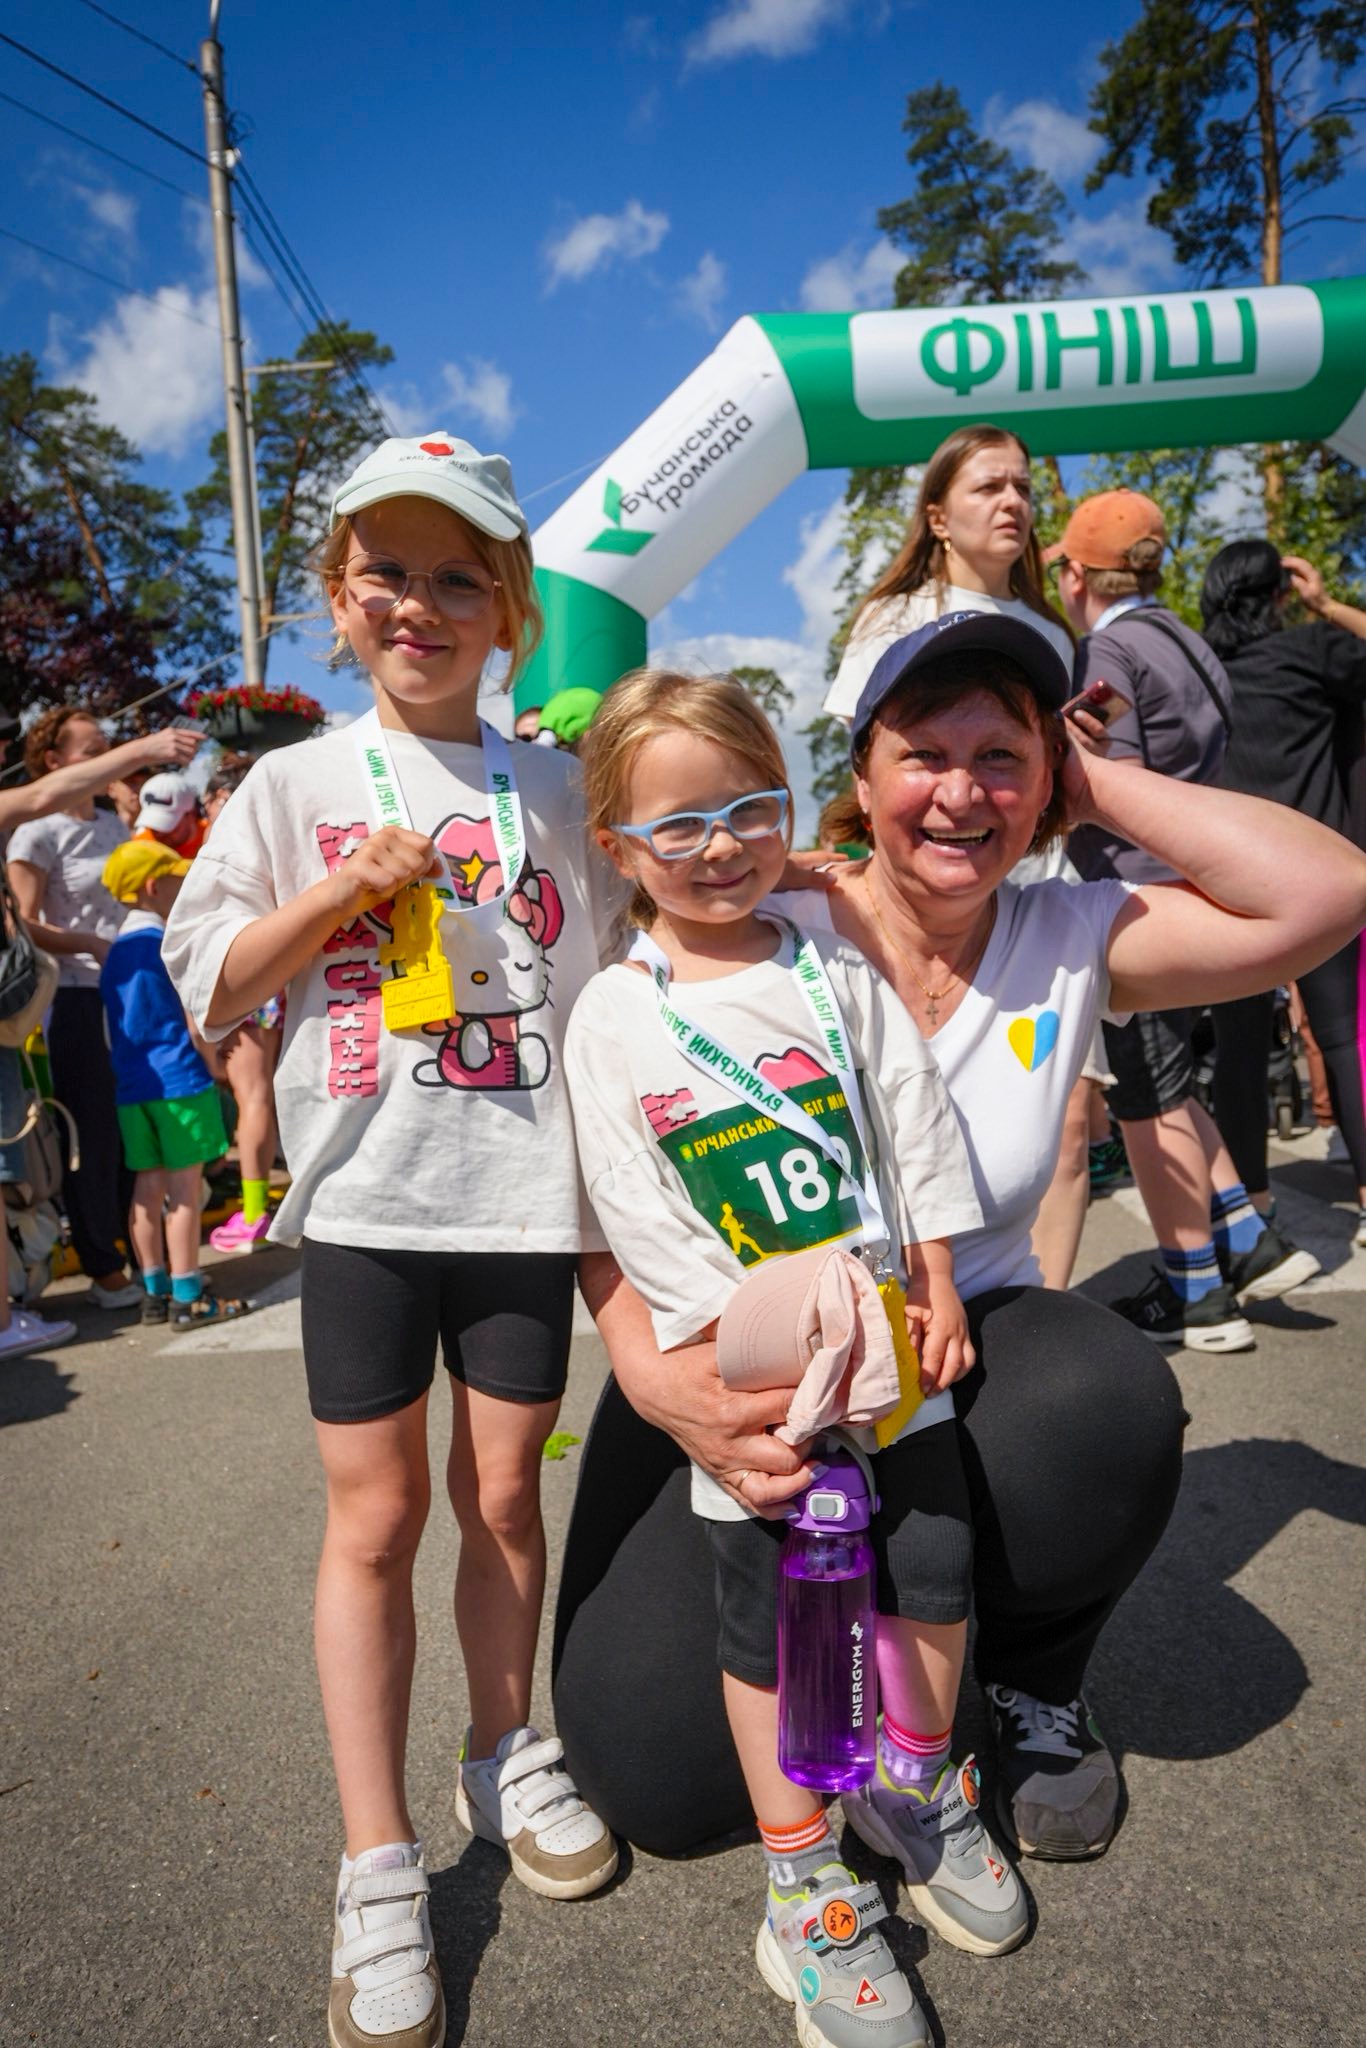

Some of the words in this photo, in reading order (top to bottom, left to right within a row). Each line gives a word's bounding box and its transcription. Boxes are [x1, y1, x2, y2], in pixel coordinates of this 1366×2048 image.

[920, 297, 1258, 396] ФІНІШ
[619, 398, 738, 514] Бучанська
[655, 414, 754, 513] громада
[365, 748, 388, 779] МИРУ
[375, 783, 400, 815] ЗАБІГ
[491, 772, 523, 849] БУЧАНСЬКИЙ
[806, 985, 837, 1025] ЗАБІГ
[825, 1027, 850, 1073] МИРУ
[686, 1033, 784, 1112] БУЧАНСЬКИЙ
[692, 1115, 781, 1158] БУЧАНСЬКИ
[826, 1091, 849, 1112] МИ
[851, 1644, 863, 1729] ENERGYM
[919, 1795, 964, 1827] weestep
